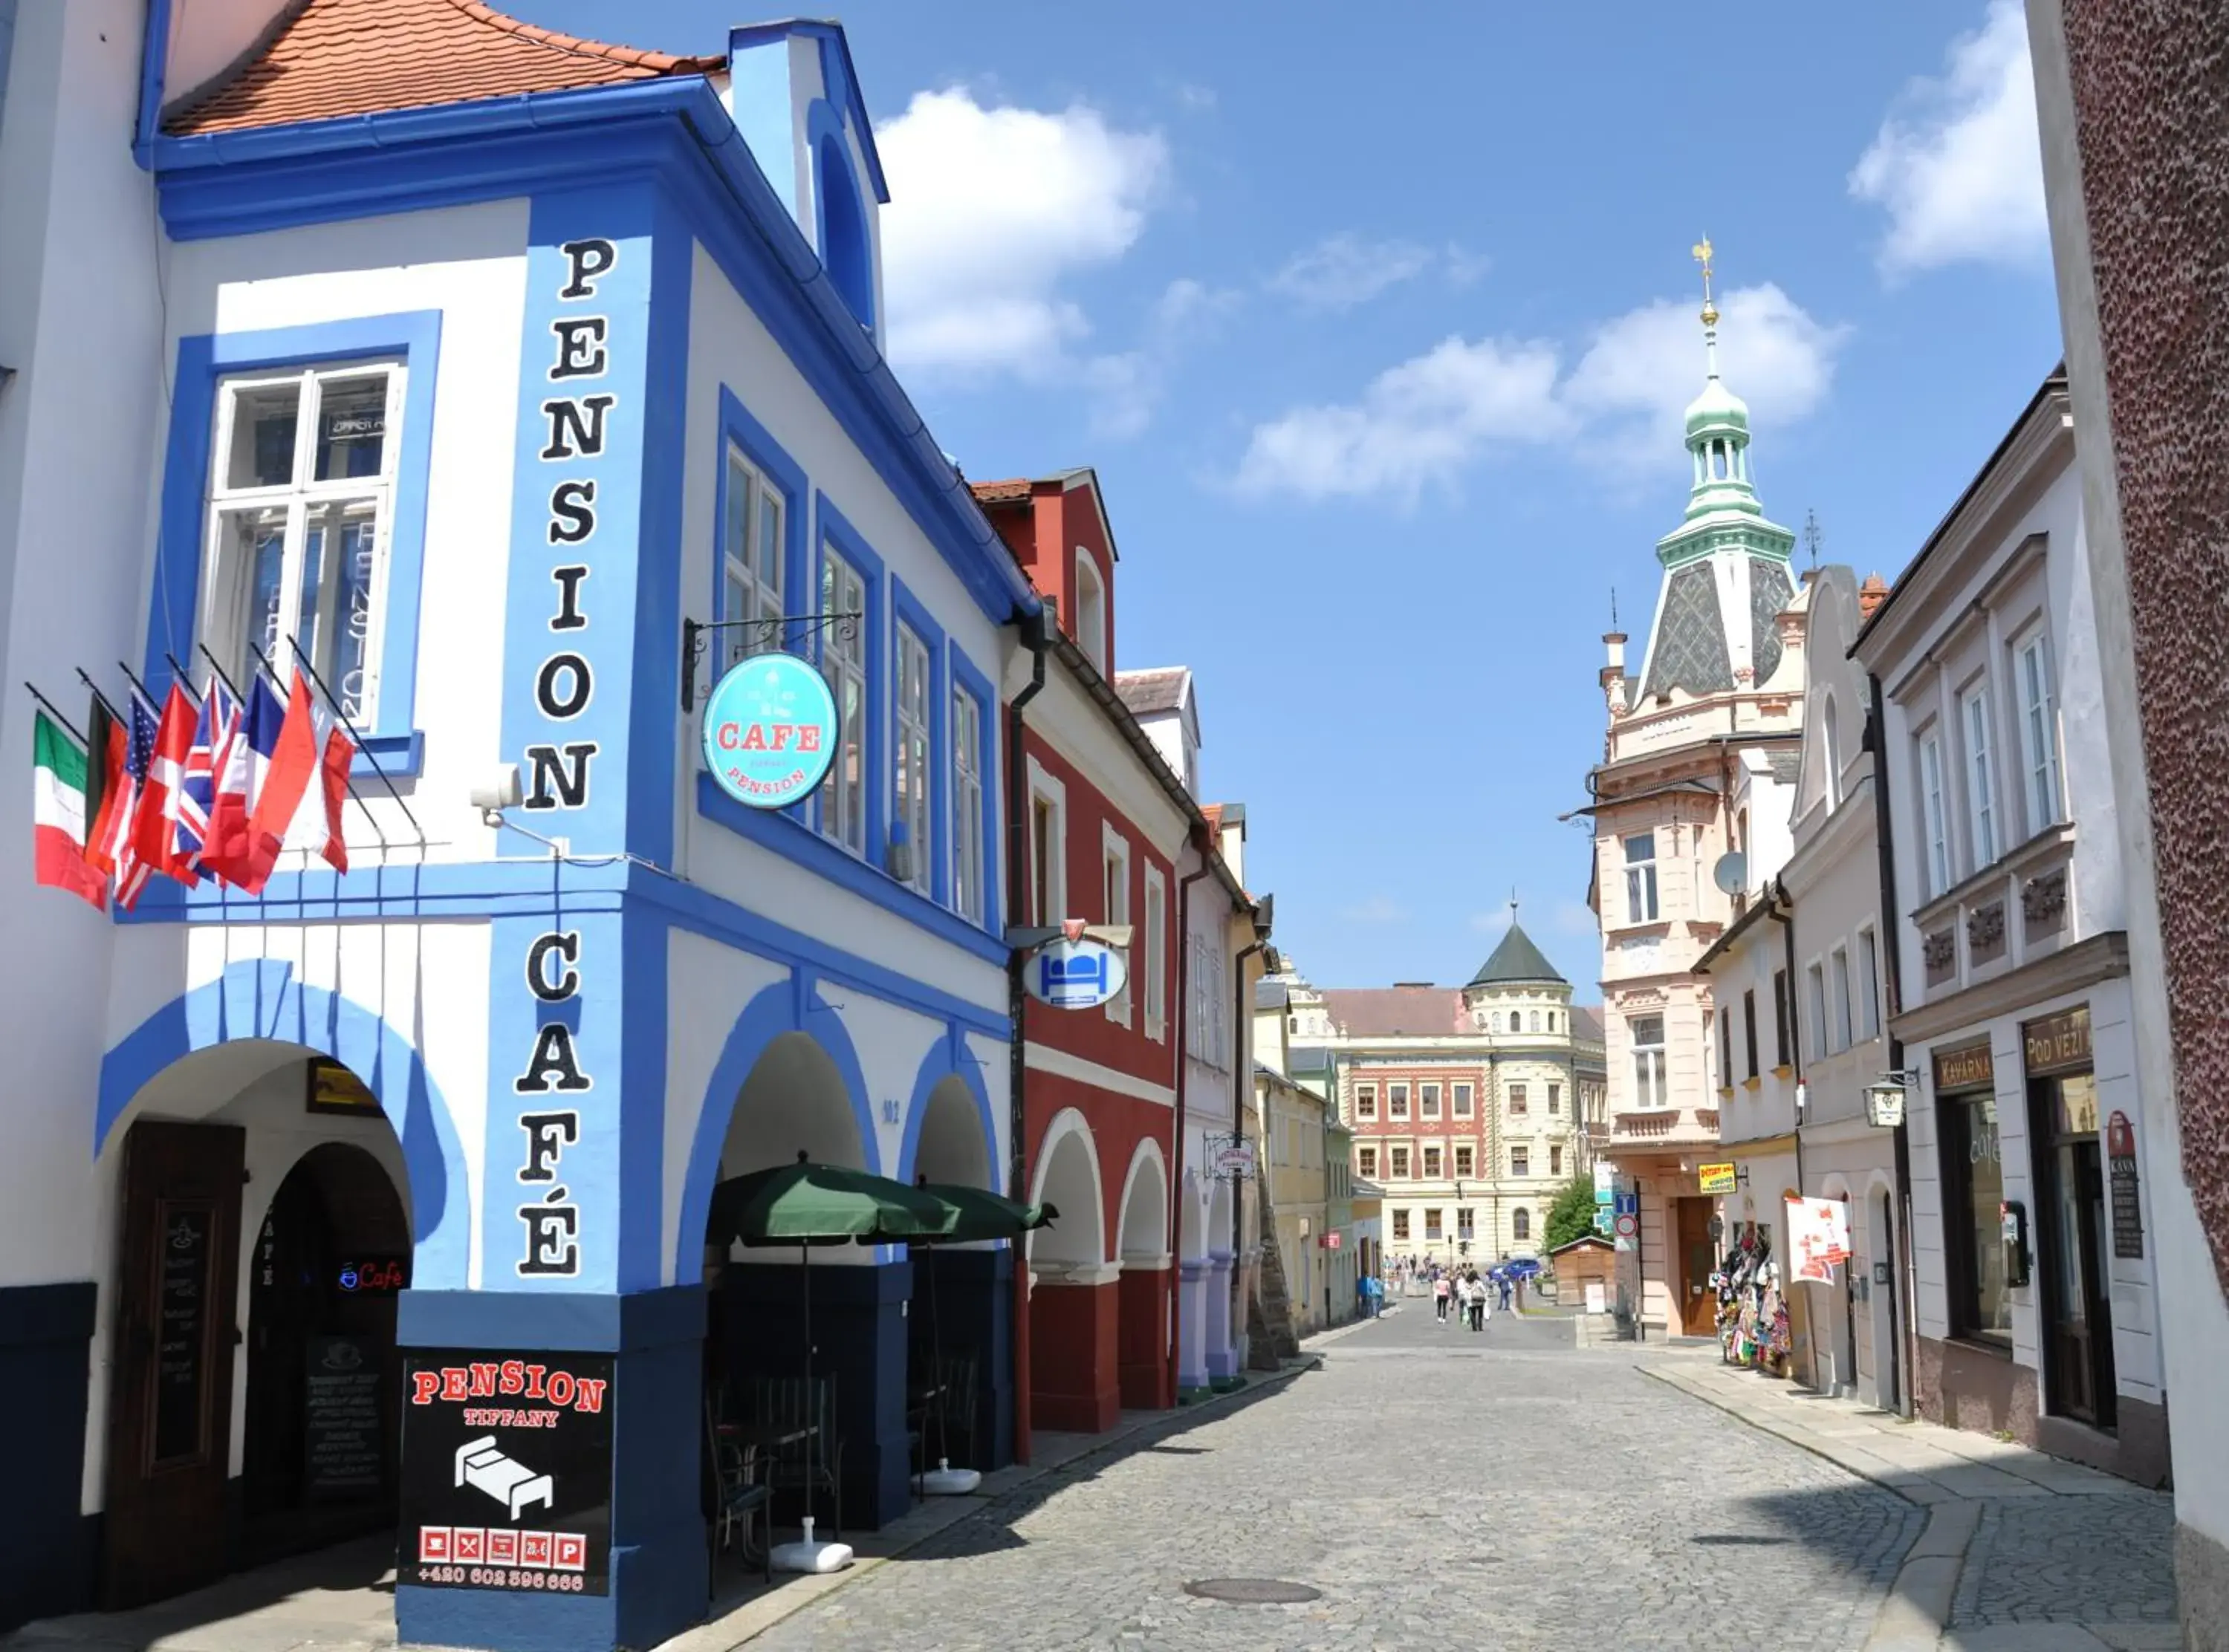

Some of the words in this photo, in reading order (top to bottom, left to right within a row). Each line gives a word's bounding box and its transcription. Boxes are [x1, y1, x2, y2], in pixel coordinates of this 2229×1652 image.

[525, 239, 615, 810] PENSION
[718, 723, 820, 751] CAFE
[727, 767, 804, 794] PENSION
[2028, 1038, 2051, 1065] POD
[515, 931, 591, 1276] CAFÉ
[412, 1360, 606, 1412] PENSION
[464, 1408, 559, 1428] TIFFANY
[563, 1543, 577, 1560] P
[418, 1565, 466, 1584] +420
